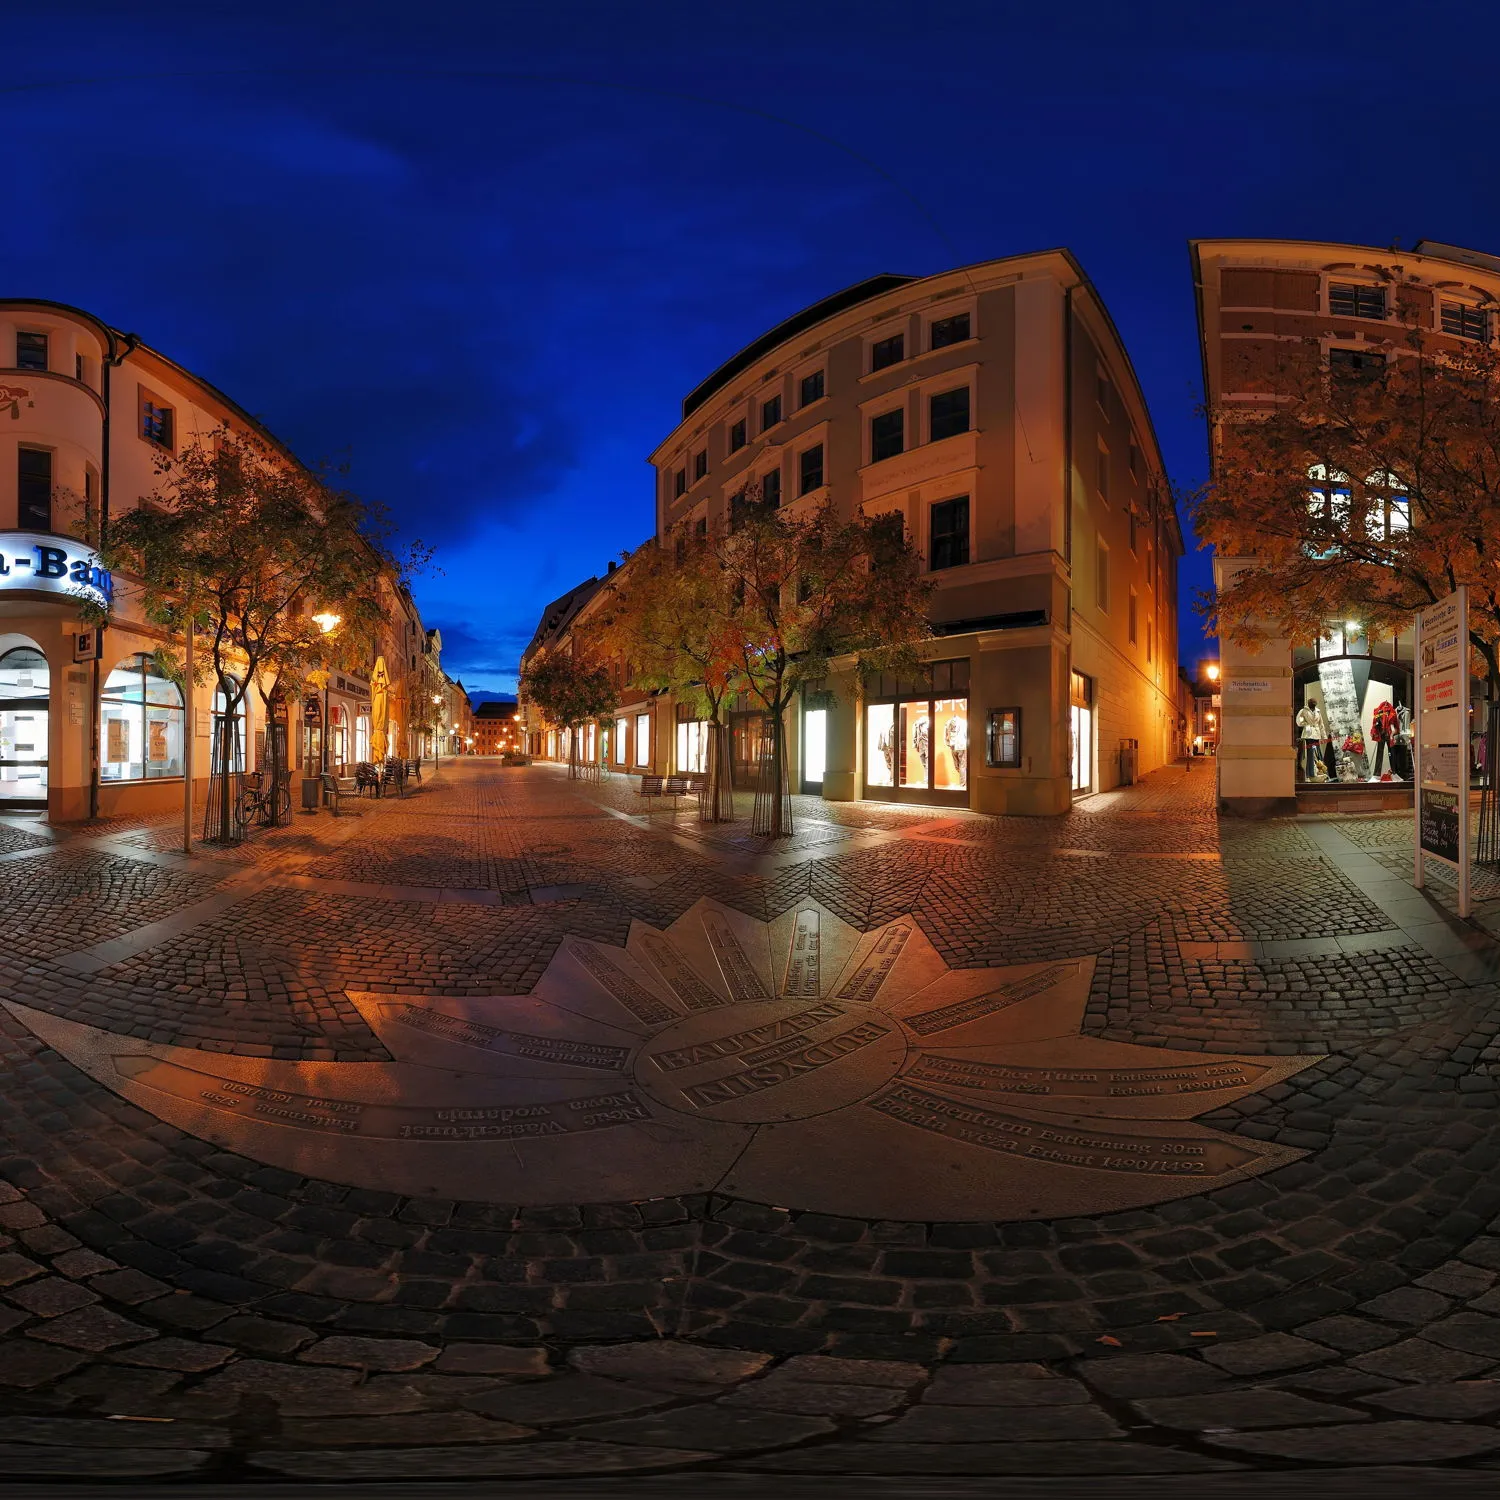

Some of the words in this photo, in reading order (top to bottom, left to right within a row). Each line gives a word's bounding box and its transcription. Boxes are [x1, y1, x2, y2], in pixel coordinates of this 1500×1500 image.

[654, 1005, 842, 1069] BAUTZEN
[691, 1023, 888, 1104] BUDYSIN
[918, 1057, 1033, 1080] Wendischer
[1039, 1070, 1098, 1082] Turm
[397, 1118, 567, 1137] Wasserkunst
[433, 1105, 551, 1121] wodarnja
[871, 1097, 955, 1131] Bohata
[888, 1086, 1037, 1136] Reichenturm
[1034, 1129, 1152, 1154] Entfernung
[1159, 1143, 1204, 1155] 80m
